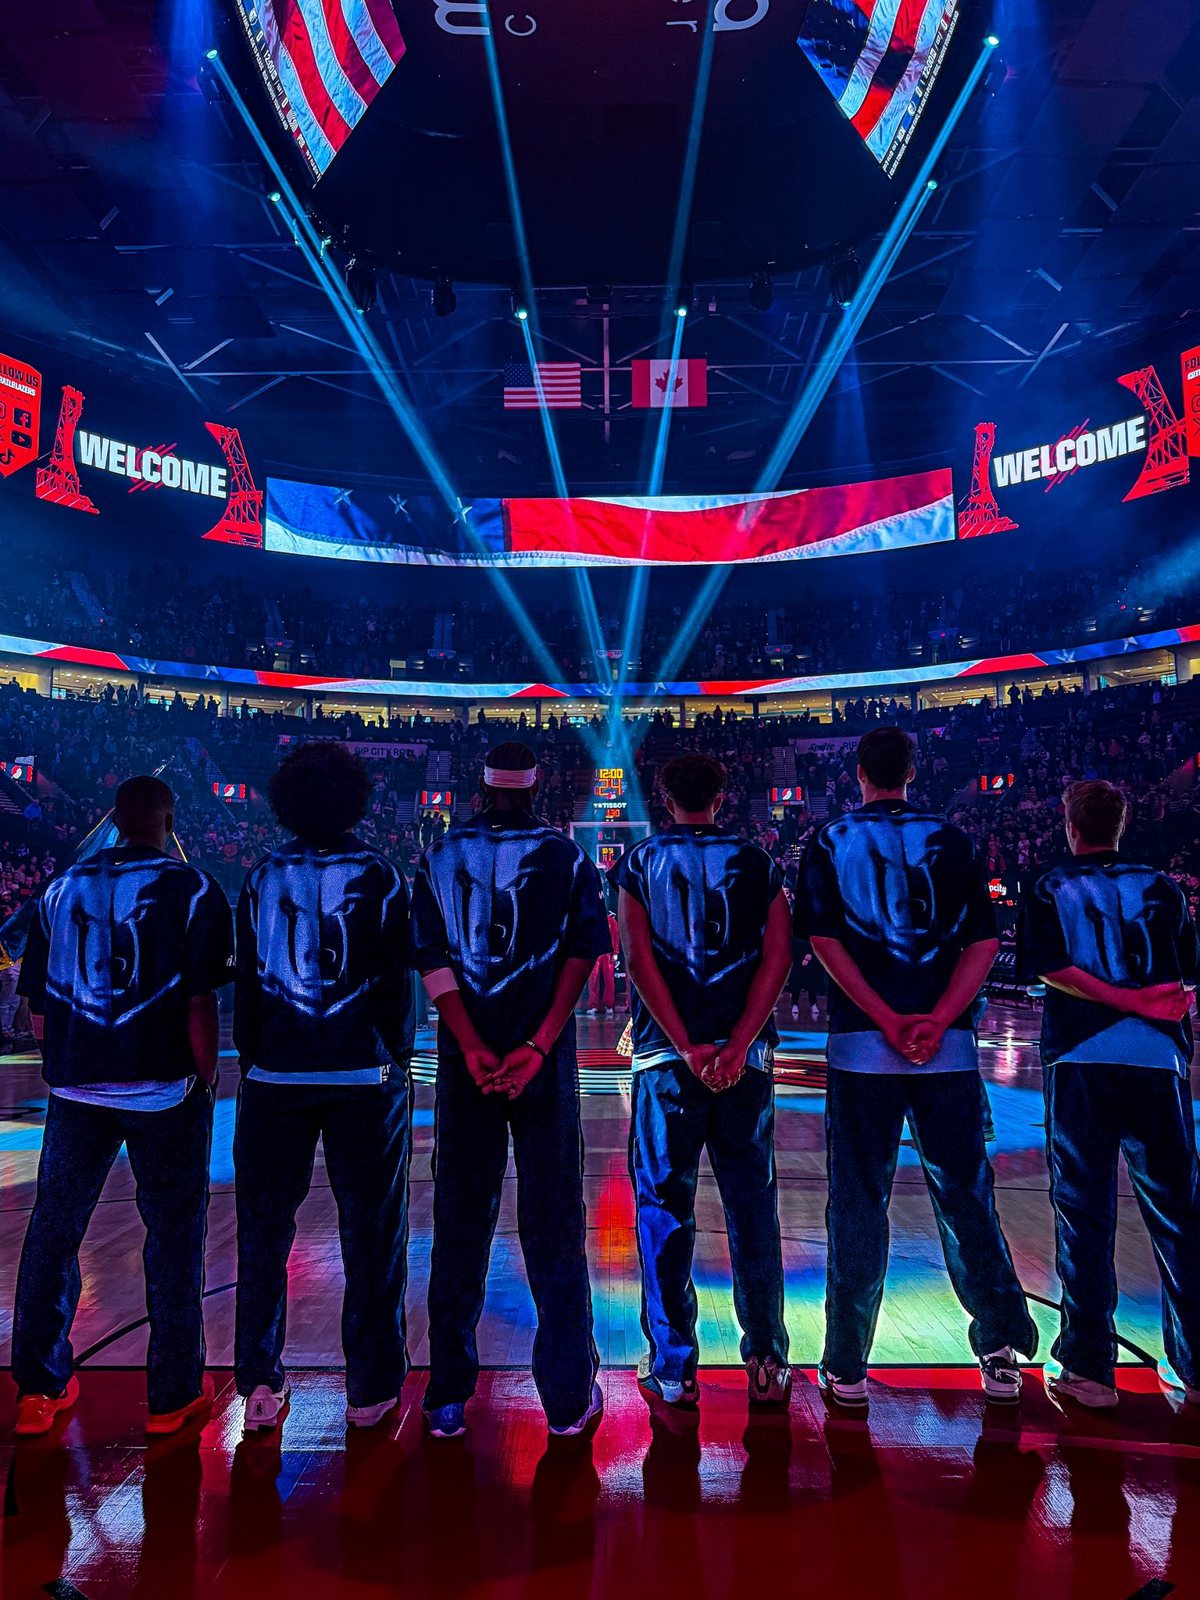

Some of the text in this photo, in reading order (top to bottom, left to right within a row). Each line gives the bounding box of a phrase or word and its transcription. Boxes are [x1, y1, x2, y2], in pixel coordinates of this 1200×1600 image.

[26, 372, 39, 387] US
[79, 430, 228, 499] WELCOME
[992, 415, 1146, 488] WELCOME
[599, 769, 624, 779] 12:00
